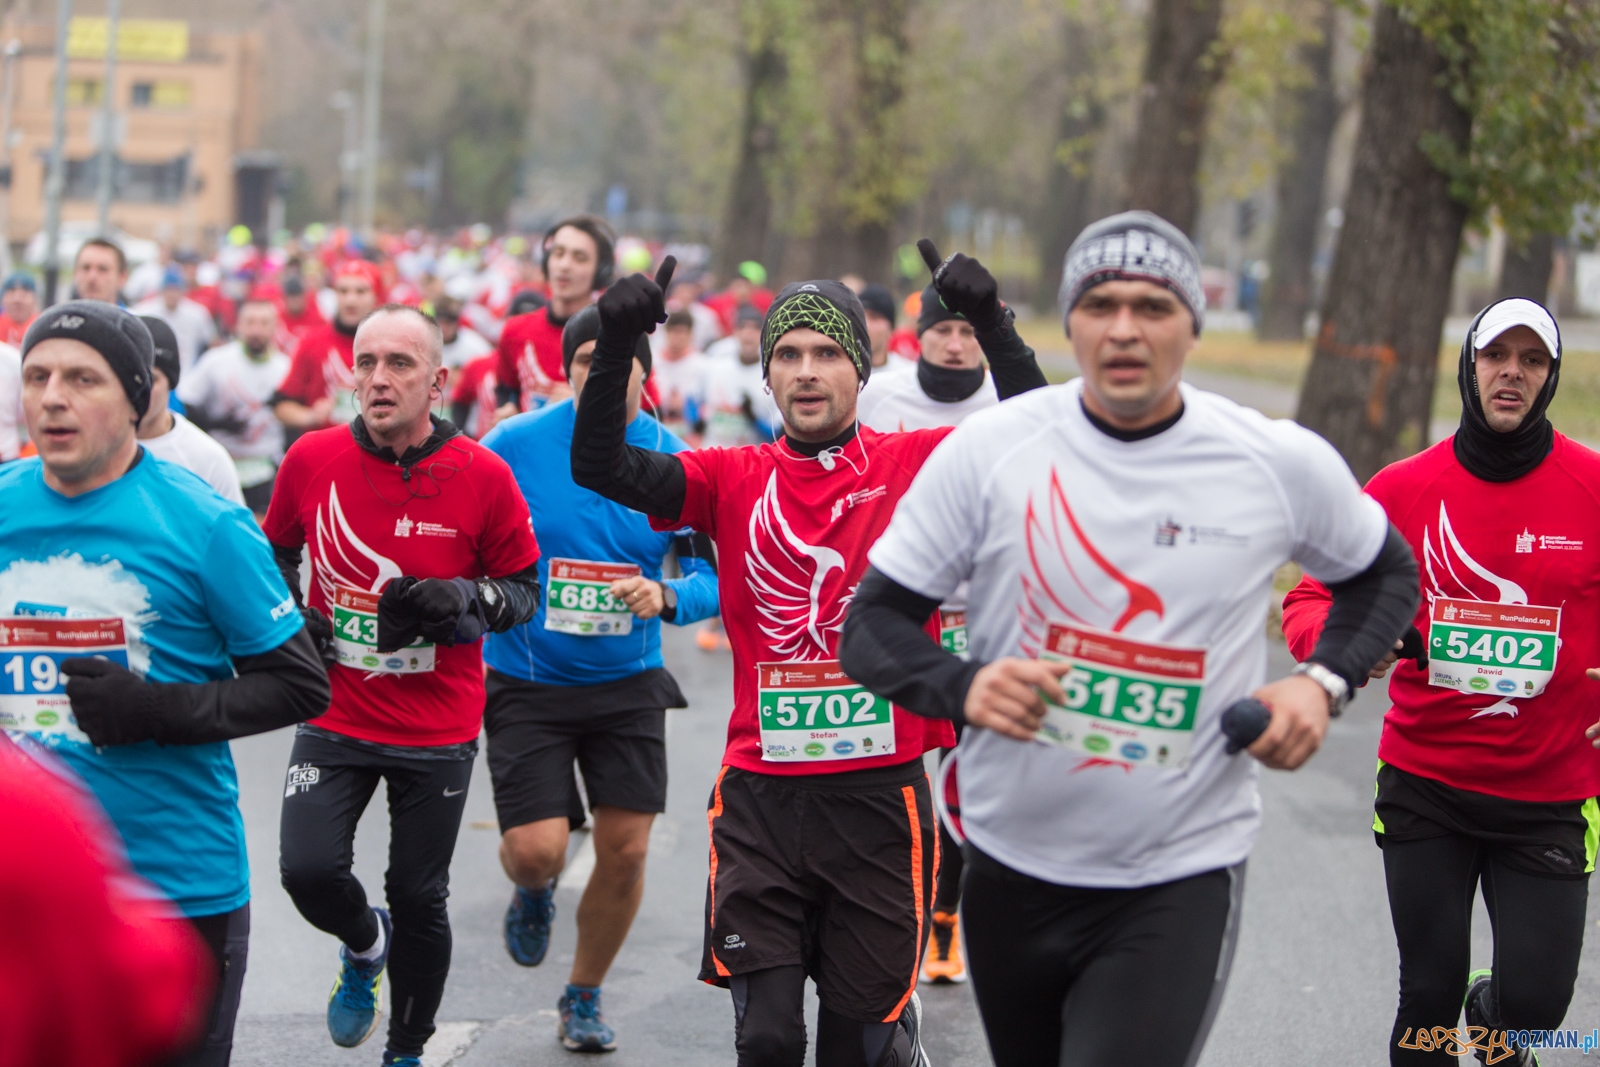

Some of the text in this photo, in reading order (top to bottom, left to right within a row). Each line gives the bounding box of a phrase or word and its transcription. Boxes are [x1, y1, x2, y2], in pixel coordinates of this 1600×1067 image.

[1499, 614, 1551, 626] RunPoland.org
[953, 630, 968, 651] 5
[1445, 630, 1544, 667] 5402
[824, 670, 848, 680] RunP
[1477, 667, 1503, 676] Dawid
[1060, 669, 1189, 728] 5135
[776, 691, 877, 727] 5702
[810, 731, 839, 739] Stefan
